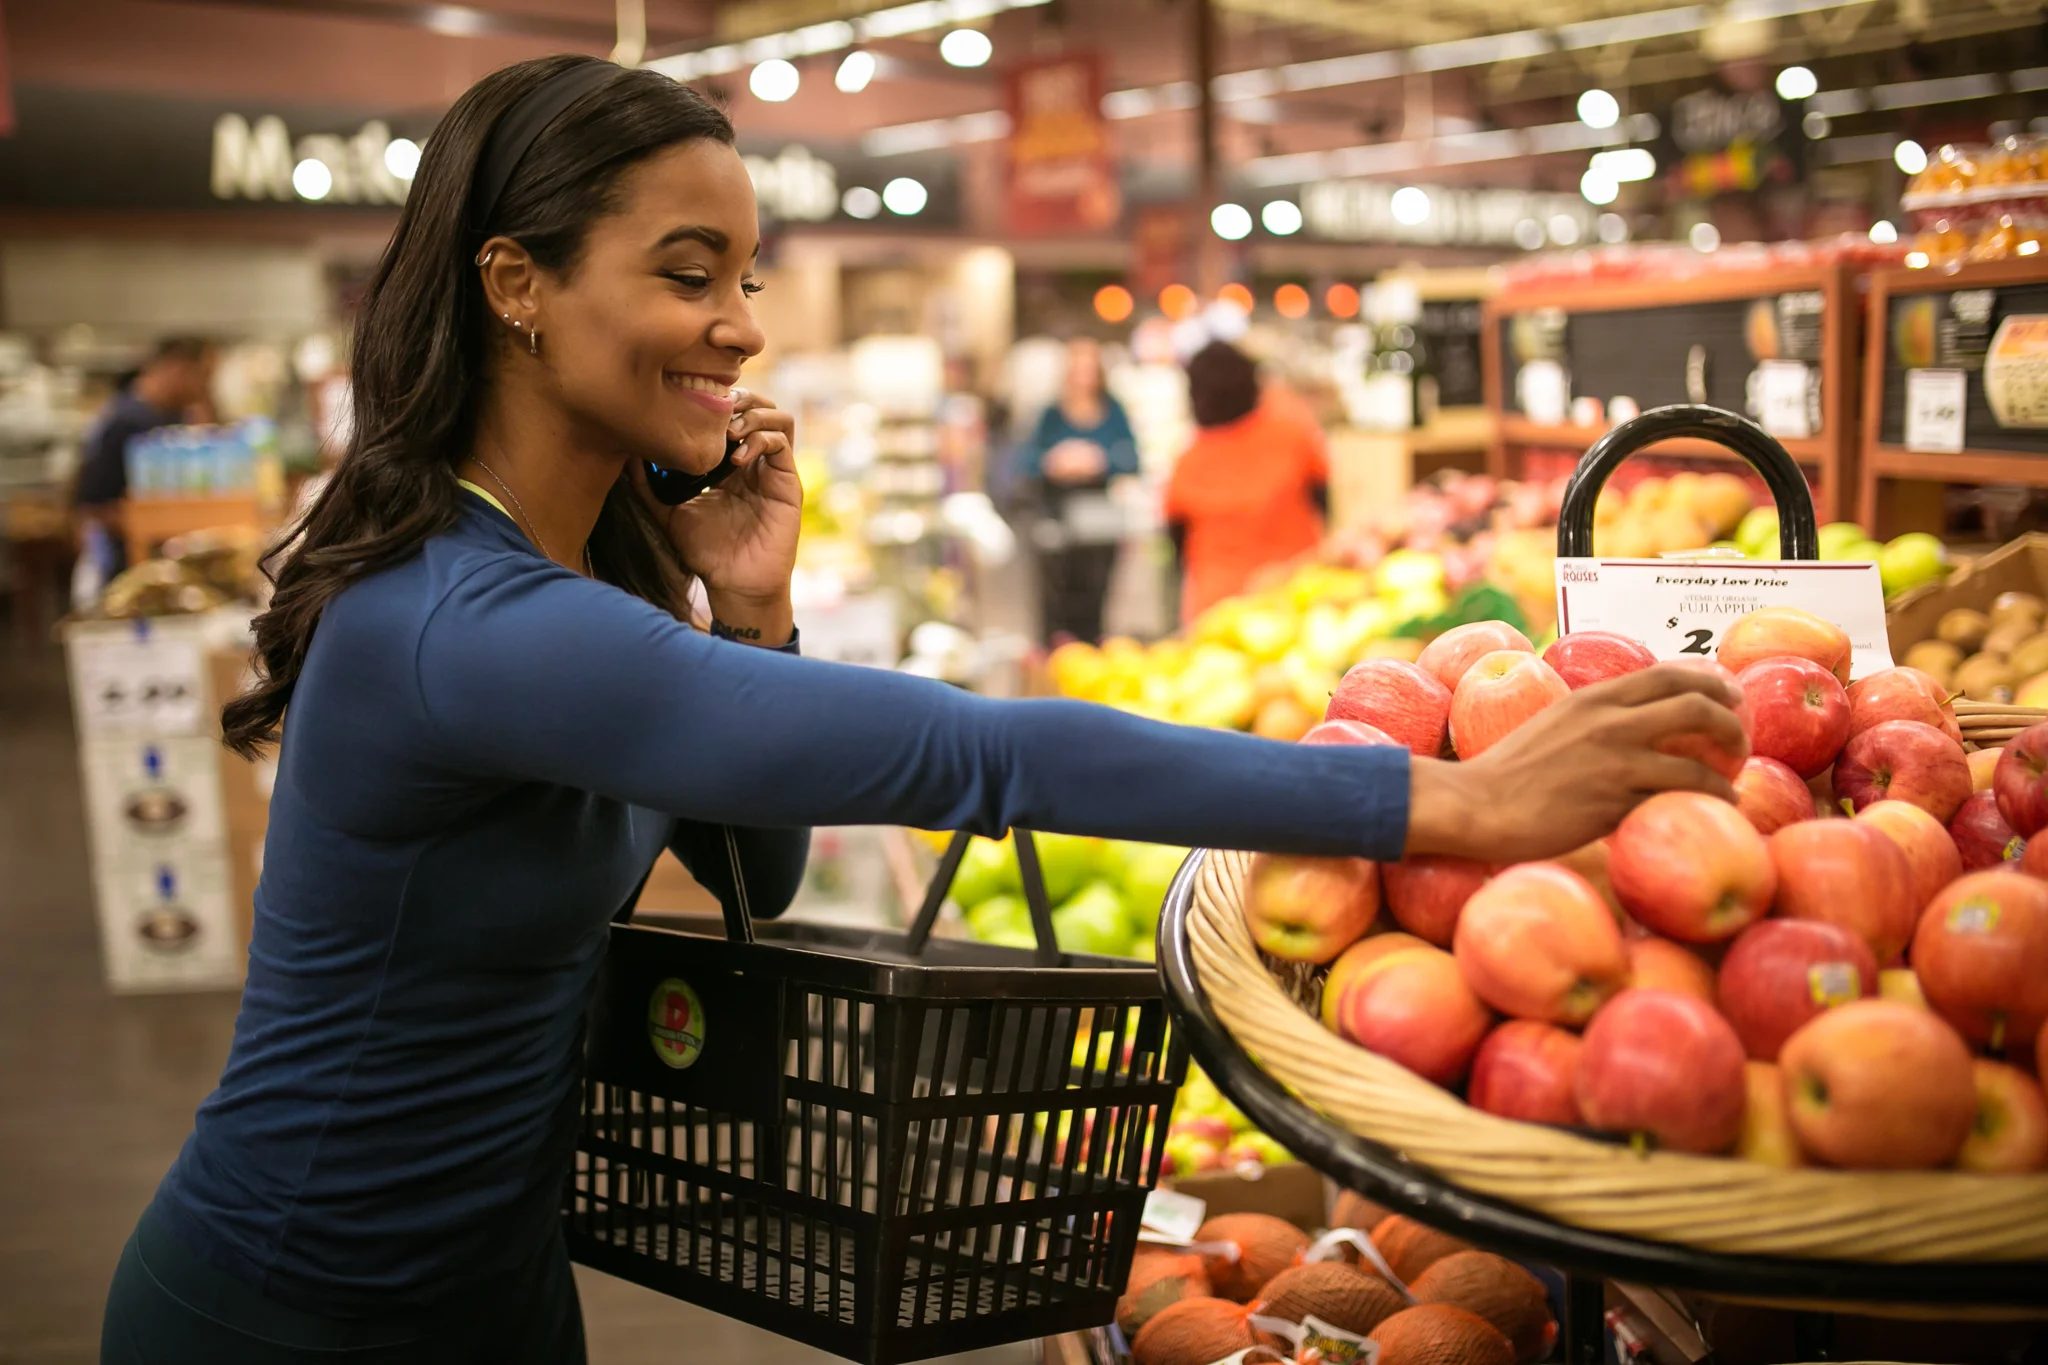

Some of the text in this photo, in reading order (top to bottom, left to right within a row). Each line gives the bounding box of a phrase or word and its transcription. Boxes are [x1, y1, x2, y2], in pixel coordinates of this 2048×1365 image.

[1563, 570, 1598, 582] ROUSES
[1656, 576, 1788, 587] Everyday Low Price
[1680, 602, 1709, 613] FUJI
